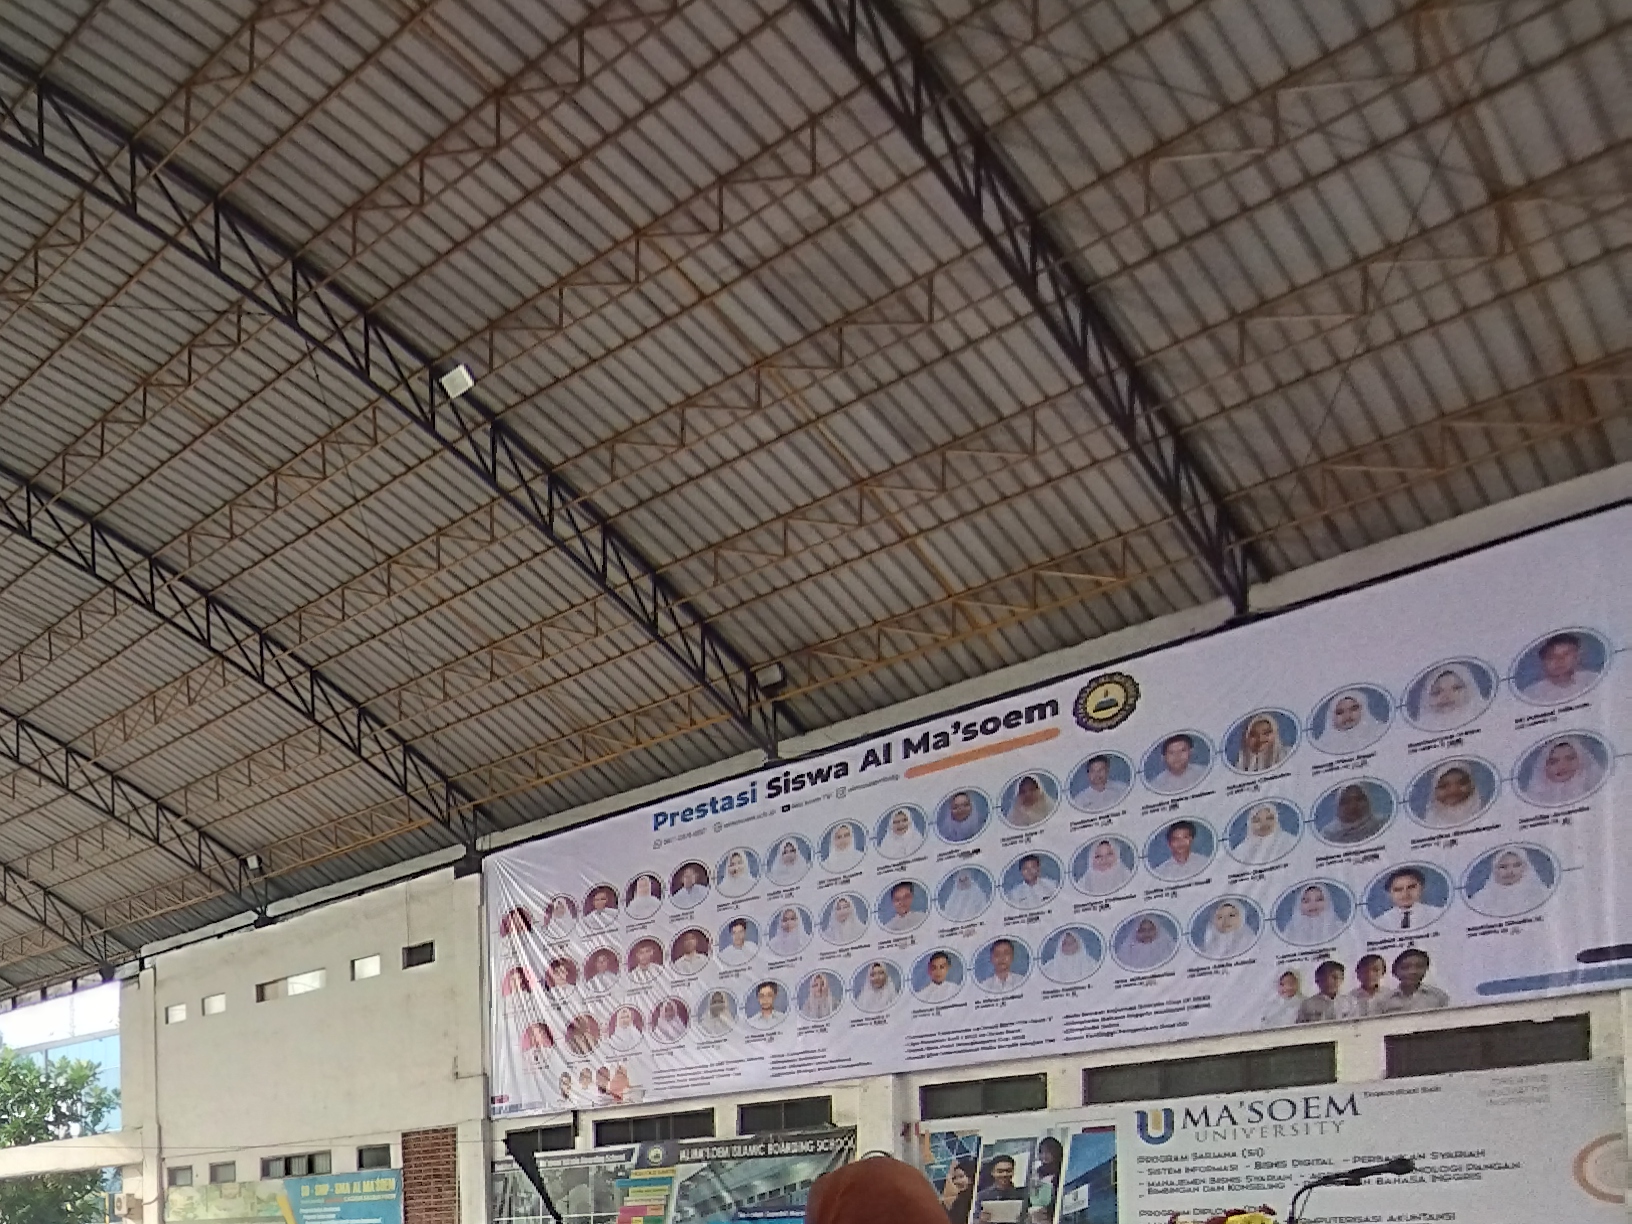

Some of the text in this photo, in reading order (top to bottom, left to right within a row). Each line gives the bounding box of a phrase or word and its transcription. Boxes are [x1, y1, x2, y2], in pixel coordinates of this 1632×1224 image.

[653, 781, 758, 831] Prestasi
[766, 761, 849, 799] Siswa
[858, 742, 893, 773] Al
[901, 699, 1059, 760] Ma'soem
[1181, 1092, 1361, 1130] MA'SOEM
[1194, 1119, 1345, 1143] UNIVERSITY
[768, 1138, 814, 1155] BOARDING
[1137, 1154, 1188, 1164] PROGRAM
[1429, 1148, 1486, 1160] SYARIAH
[1291, 1157, 1334, 1168] DIGITAL
[1465, 1161, 1521, 1171] PANGAN
[1147, 1163, 1239, 1176] SISTEM INFORMASI
[1147, 1177, 1206, 1187] MANAJEMEN
[1376, 1175, 1428, 1186] BAHASA
[1202, 1184, 1225, 1193] DAN
[1386, 1212, 1456, 1222] AKUNTANSI
